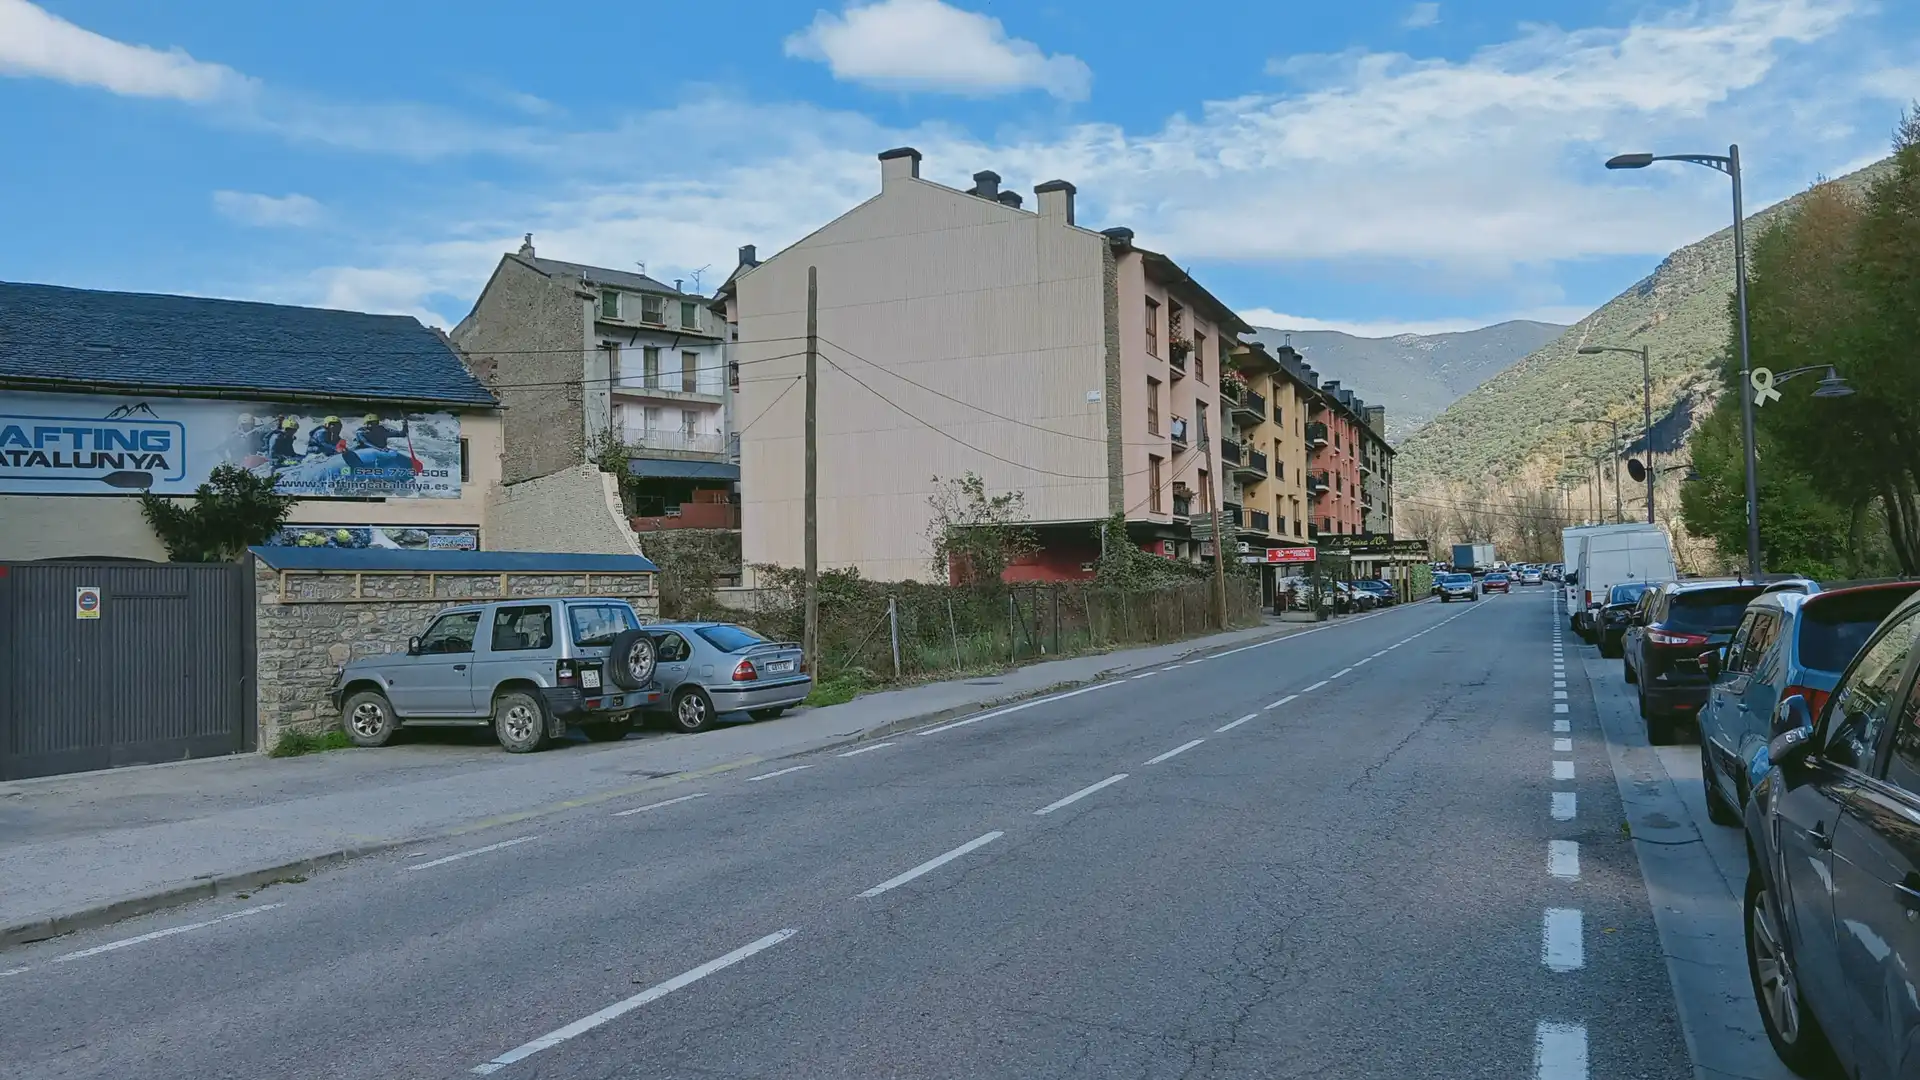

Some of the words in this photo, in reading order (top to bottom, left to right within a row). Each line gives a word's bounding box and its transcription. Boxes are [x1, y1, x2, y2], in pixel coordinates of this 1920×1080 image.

[355, 467, 384, 476] 628
[388, 467, 417, 477] 773
[421, 468, 449, 478] 508
[281, 478, 449, 491] www.raftingcatalunya.es
